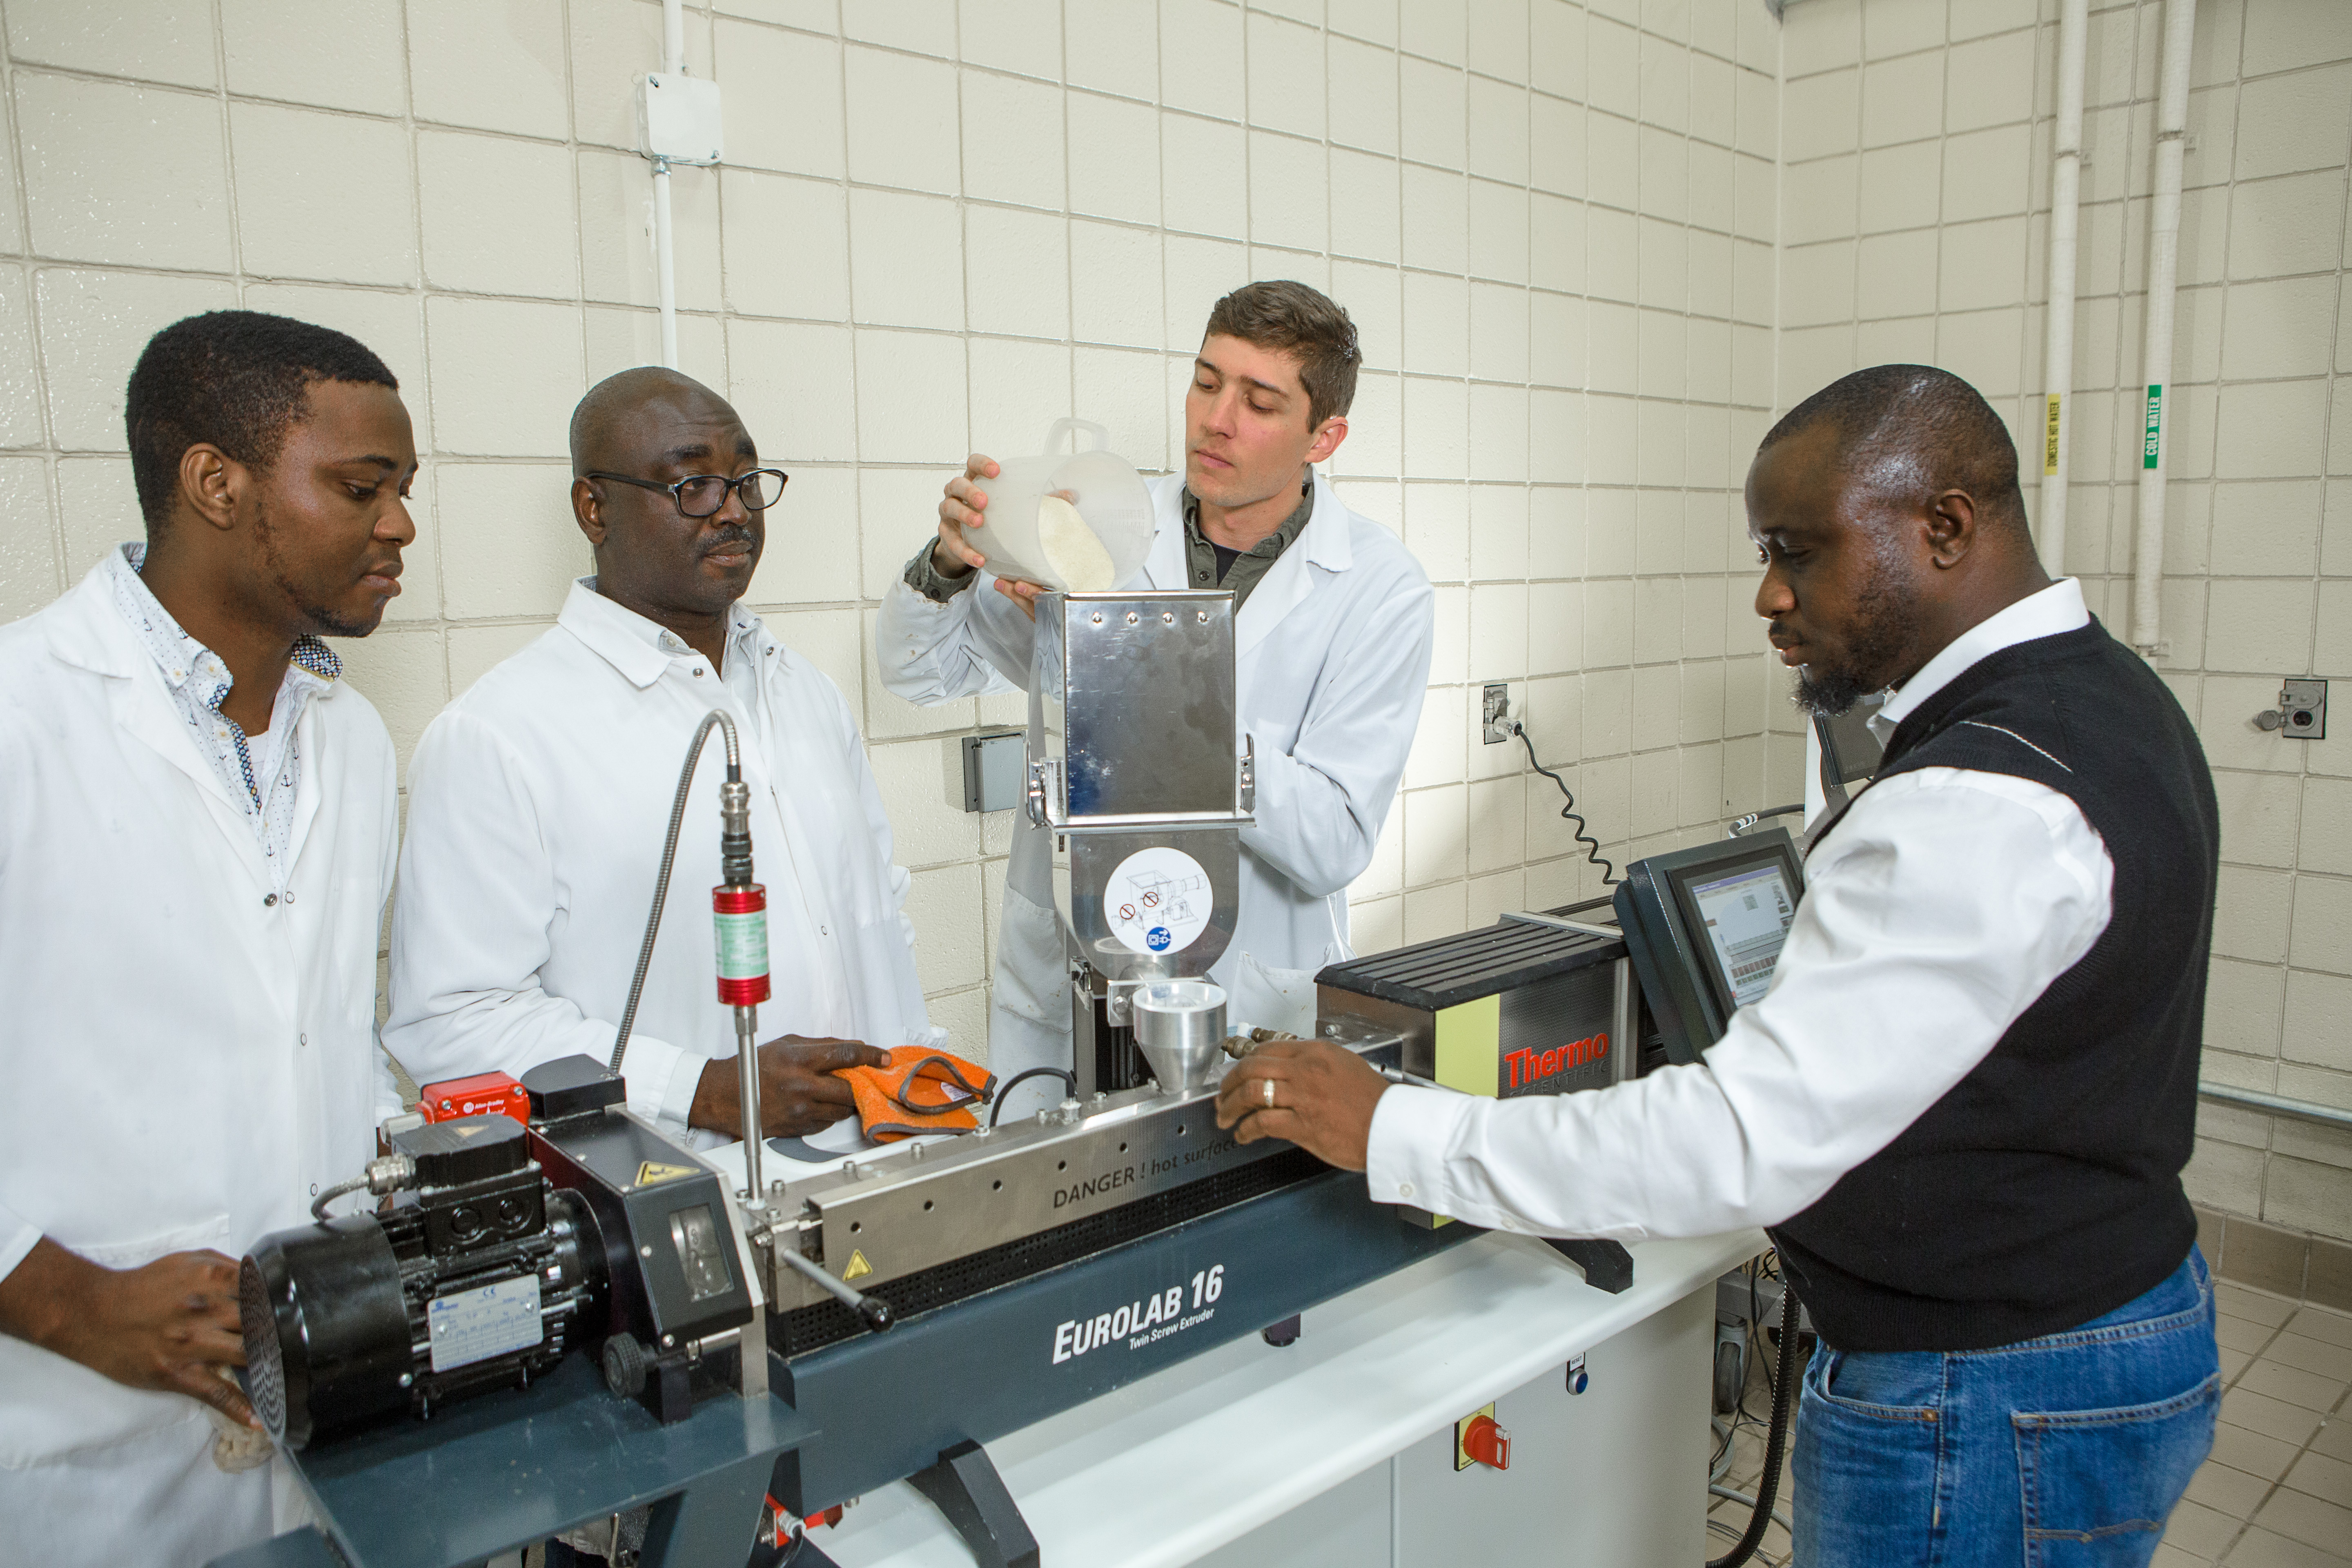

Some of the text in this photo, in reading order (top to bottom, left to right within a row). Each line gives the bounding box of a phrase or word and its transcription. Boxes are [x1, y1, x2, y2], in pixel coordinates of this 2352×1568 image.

[2047, 402, 2060, 466] DOMESTIC HOT WATER
[2146, 396, 2160, 455] COLD WATER
[1504, 1033, 1609, 1088] Thermo
[1054, 1167, 1134, 1208] DANGER
[1141, 1162, 1146, 1179] !
[1151, 1153, 1178, 1175] hot
[1053, 1264, 1225, 1365] EUROLAB 16
[1129, 1308, 1214, 1350] Twin Screw Extruder
[1571, 1355, 1582, 1365] RESET
